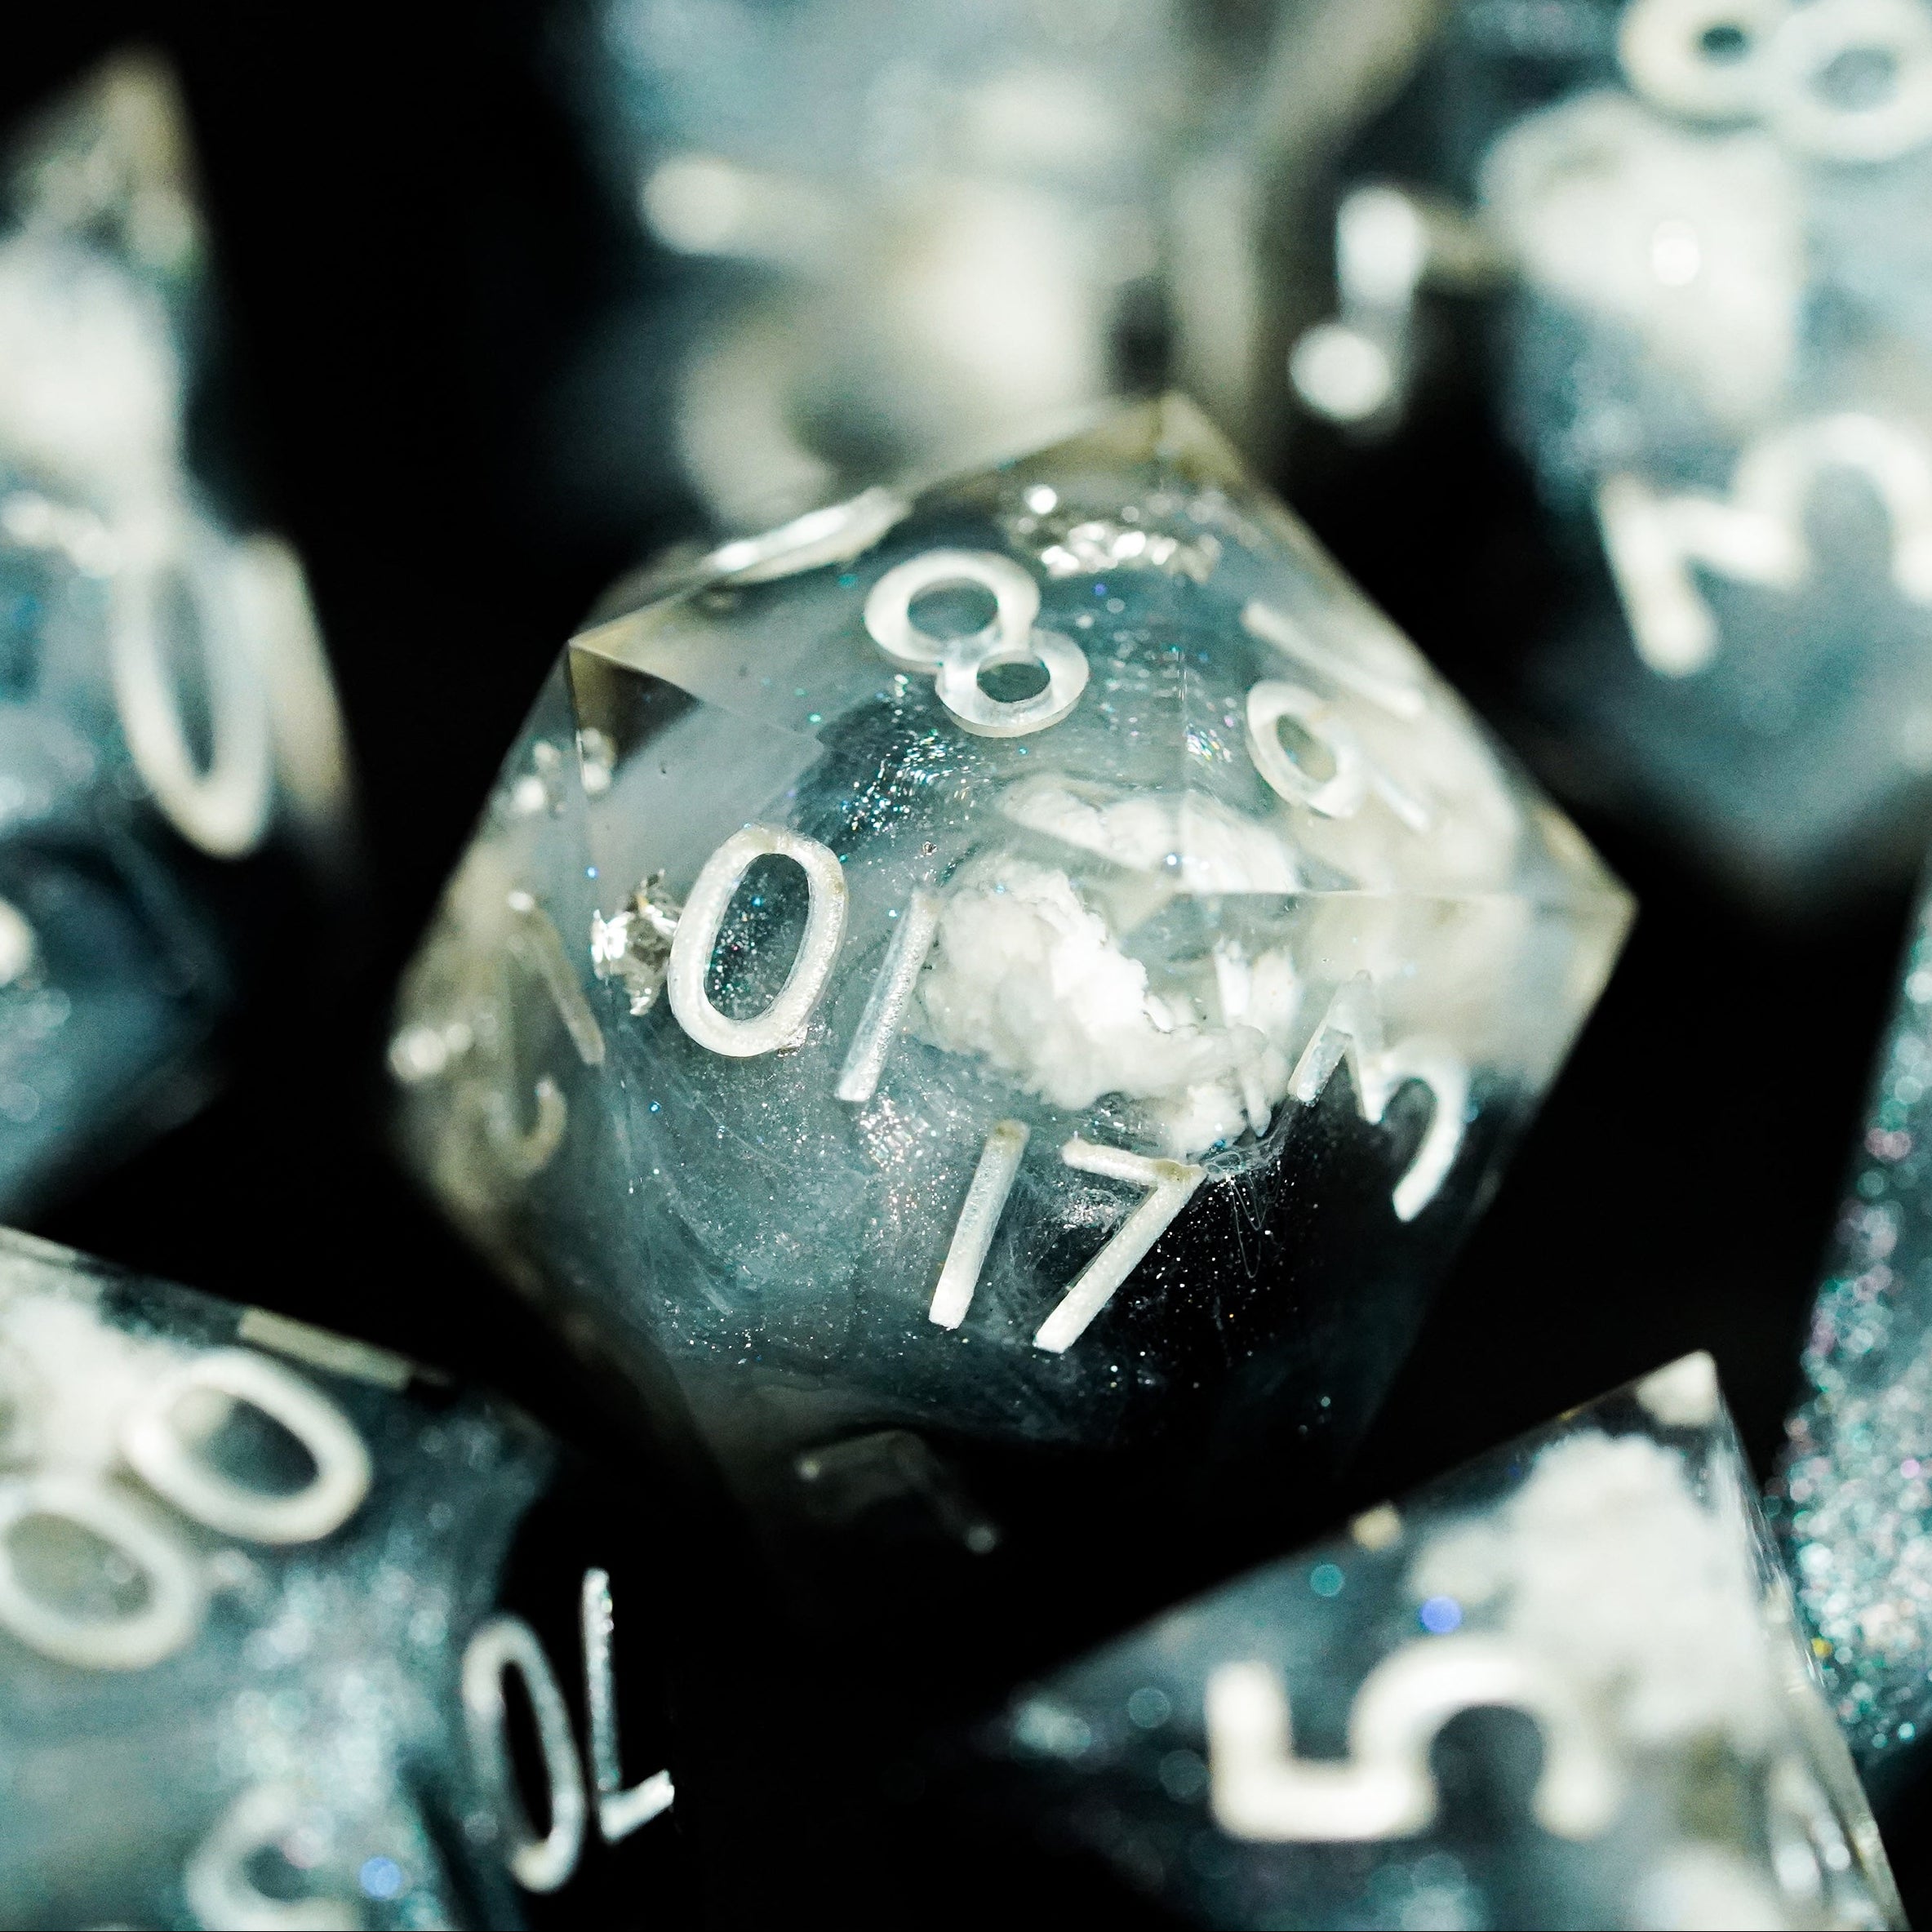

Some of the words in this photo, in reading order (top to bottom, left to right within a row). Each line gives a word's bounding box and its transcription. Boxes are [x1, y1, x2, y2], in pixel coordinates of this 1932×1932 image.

[864, 549, 1090, 738] 8
[666, 823, 940, 1102] 10
[928, 1118, 1208, 1355] 17
[1205, 1639, 1620, 1843] 5
